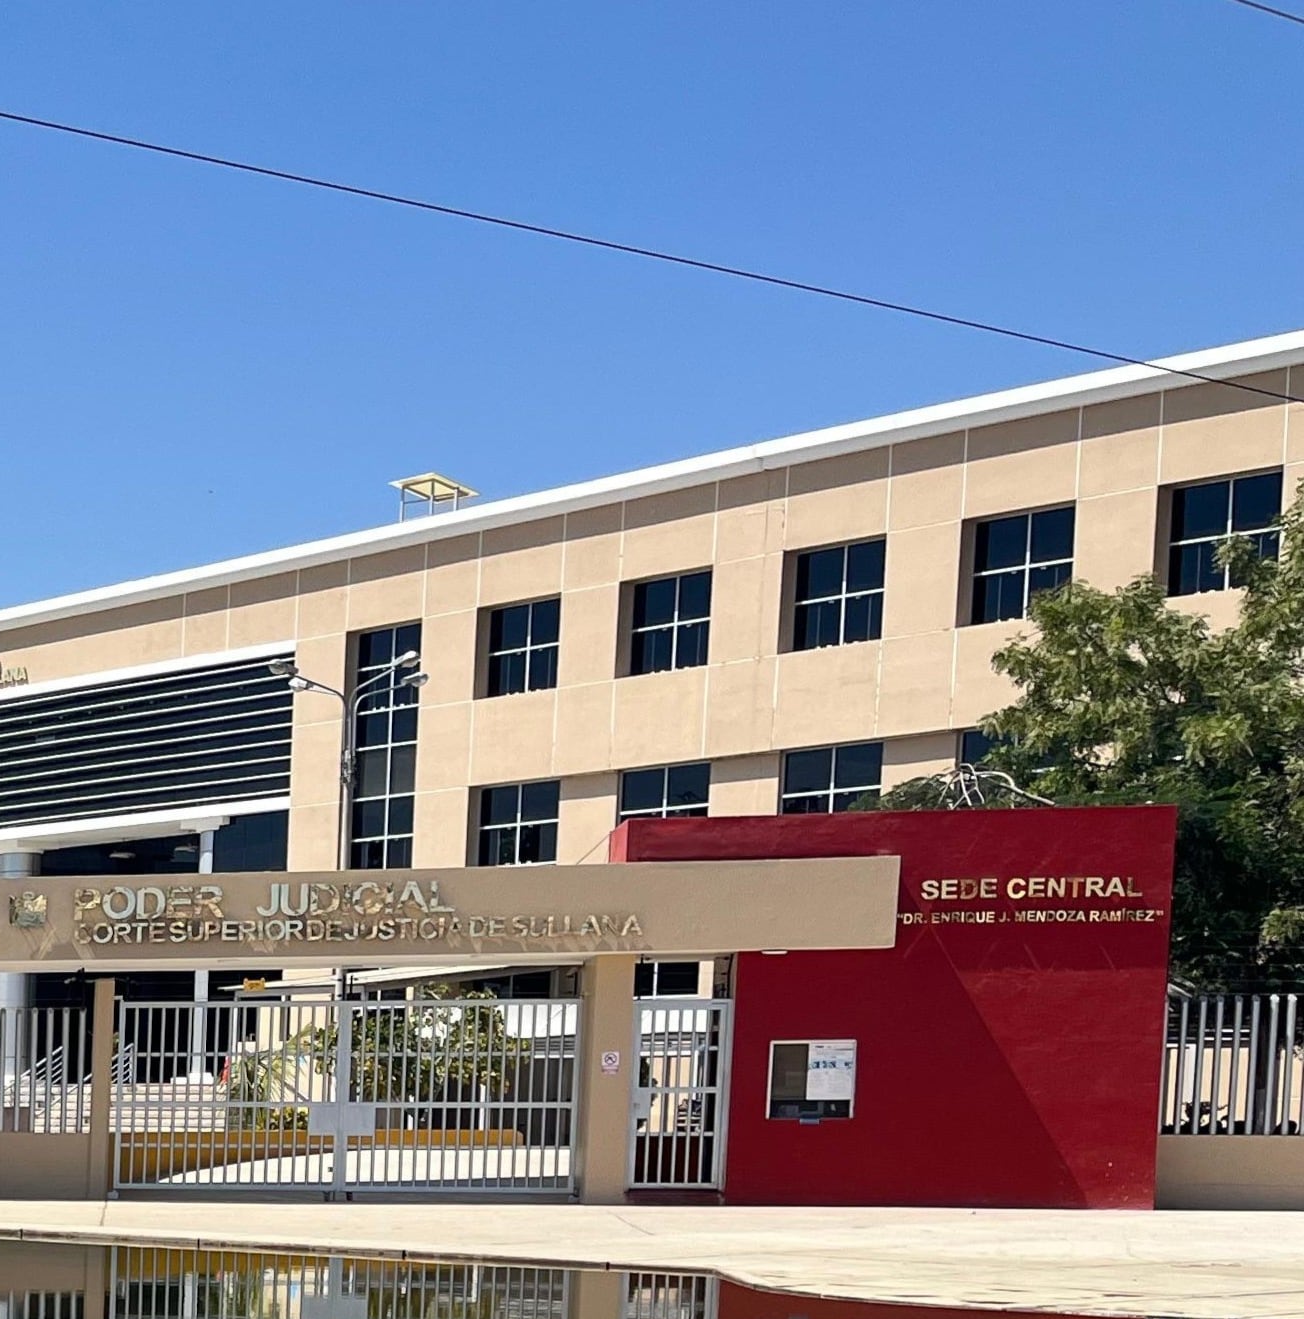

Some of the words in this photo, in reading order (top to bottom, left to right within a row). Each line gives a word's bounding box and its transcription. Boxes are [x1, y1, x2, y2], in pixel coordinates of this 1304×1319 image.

[73, 885, 225, 921] PODER
[256, 880, 455, 917] JUDICIAL
[920, 878, 998, 900] SEDE
[1006, 876, 1143, 900] CENTRAL
[73, 921, 166, 945] CORTE
[169, 919, 304, 943] SUPERIOR
[306, 919, 342, 941] DE
[343, 917, 462, 941] JUSTICIA
[469, 916, 506, 938] DE
[512, 914, 643, 938] SULLANA
[931, 911, 995, 925] ENRIQUE
[998, 911, 1011, 924] J.
[1014, 910, 1086, 923] MENDOZA
